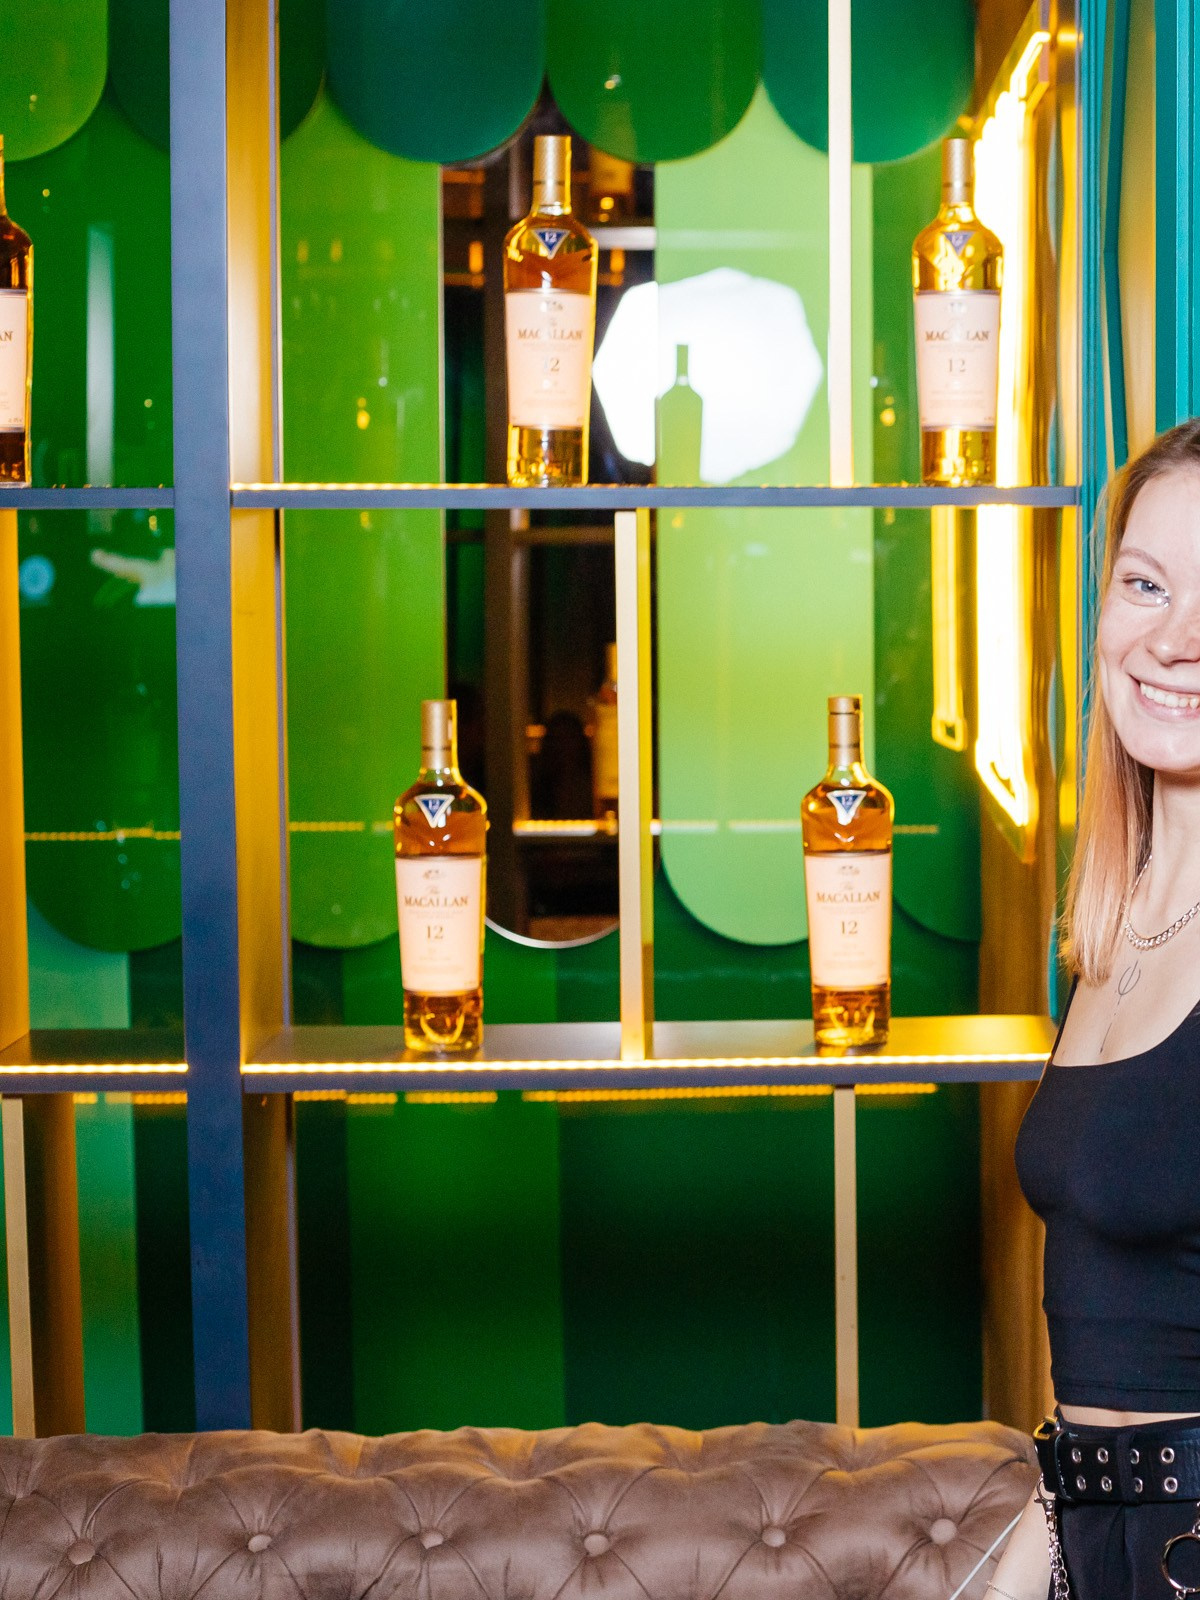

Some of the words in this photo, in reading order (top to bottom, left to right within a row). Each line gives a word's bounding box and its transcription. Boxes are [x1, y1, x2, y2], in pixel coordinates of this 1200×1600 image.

[545, 231, 557, 243] 12
[949, 358, 966, 373] 12
[841, 795, 853, 806] 12
[404, 896, 469, 907] MACALLAN
[816, 891, 881, 903] MACALLAN
[427, 925, 444, 940] 12
[841, 920, 858, 935] 12
